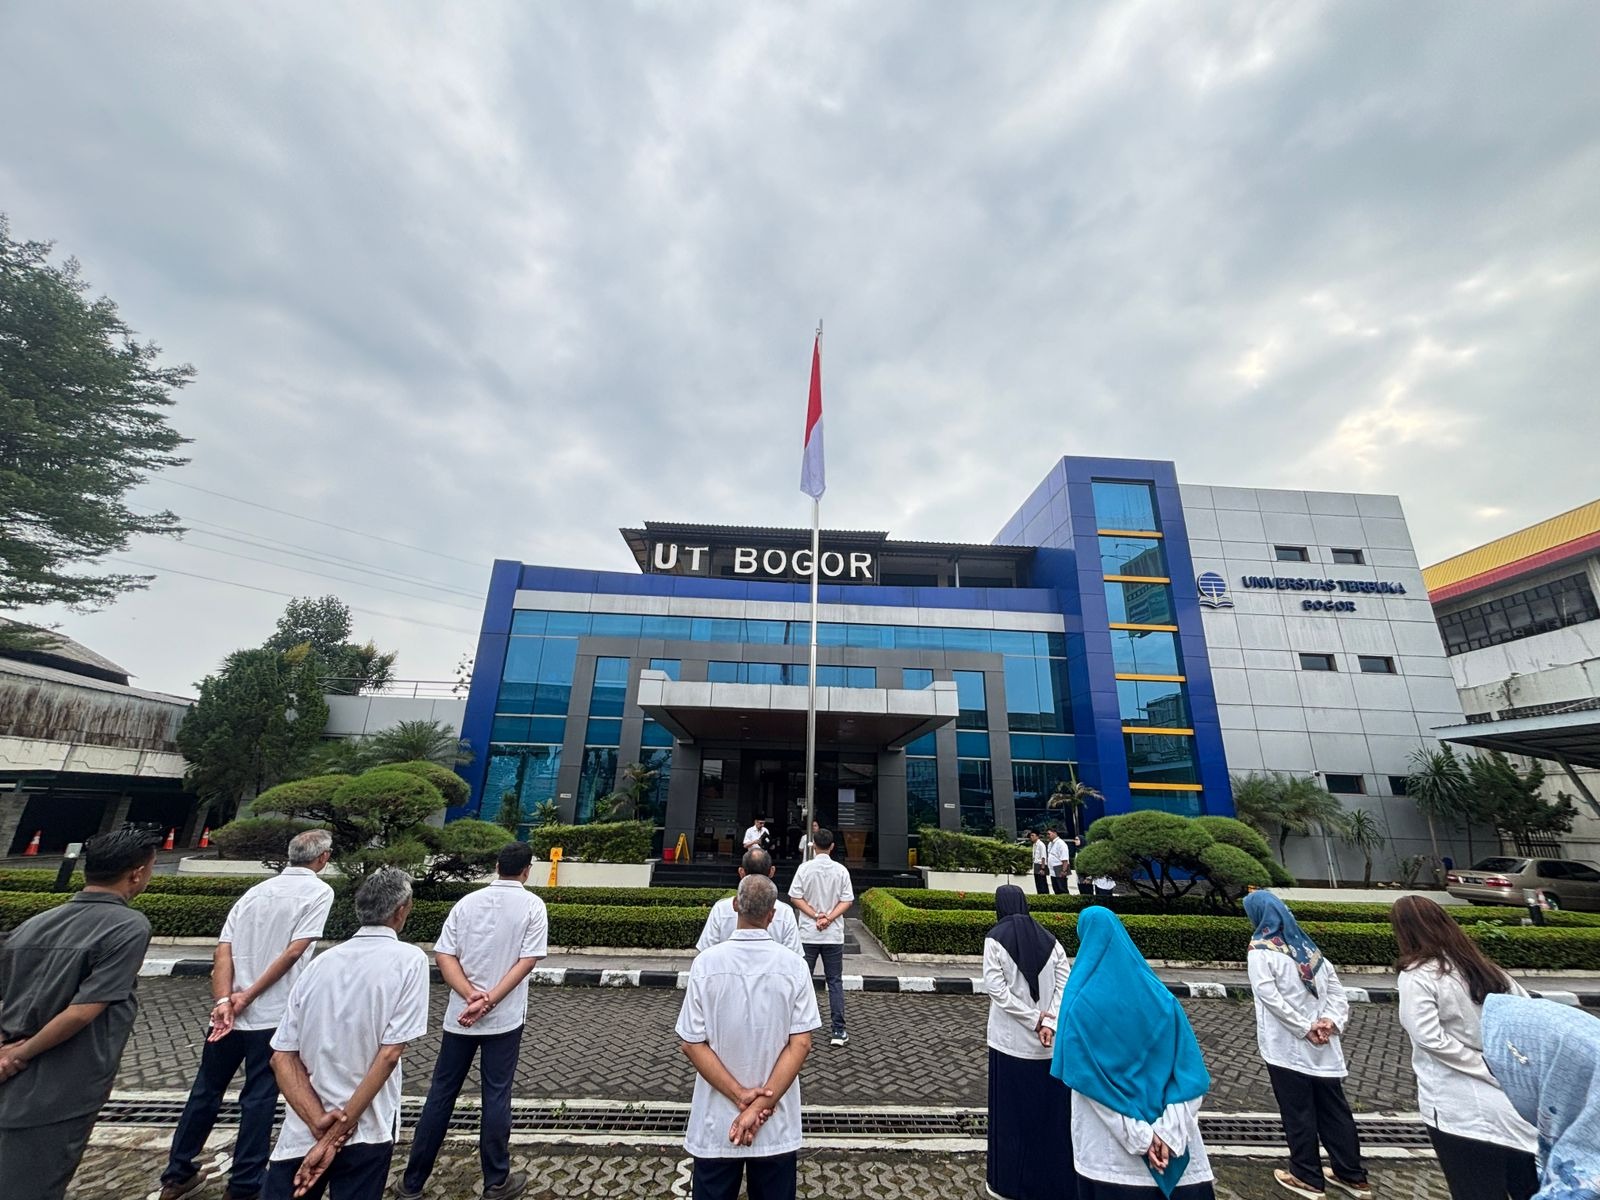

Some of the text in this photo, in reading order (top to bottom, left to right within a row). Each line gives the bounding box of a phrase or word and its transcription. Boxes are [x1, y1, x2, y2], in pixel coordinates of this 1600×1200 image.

[654, 543, 873, 579] UT BOGOR
[1241, 575, 1407, 595] UNIVERSITAS TERBUKA
[1302, 599, 1358, 612] BOGOR
